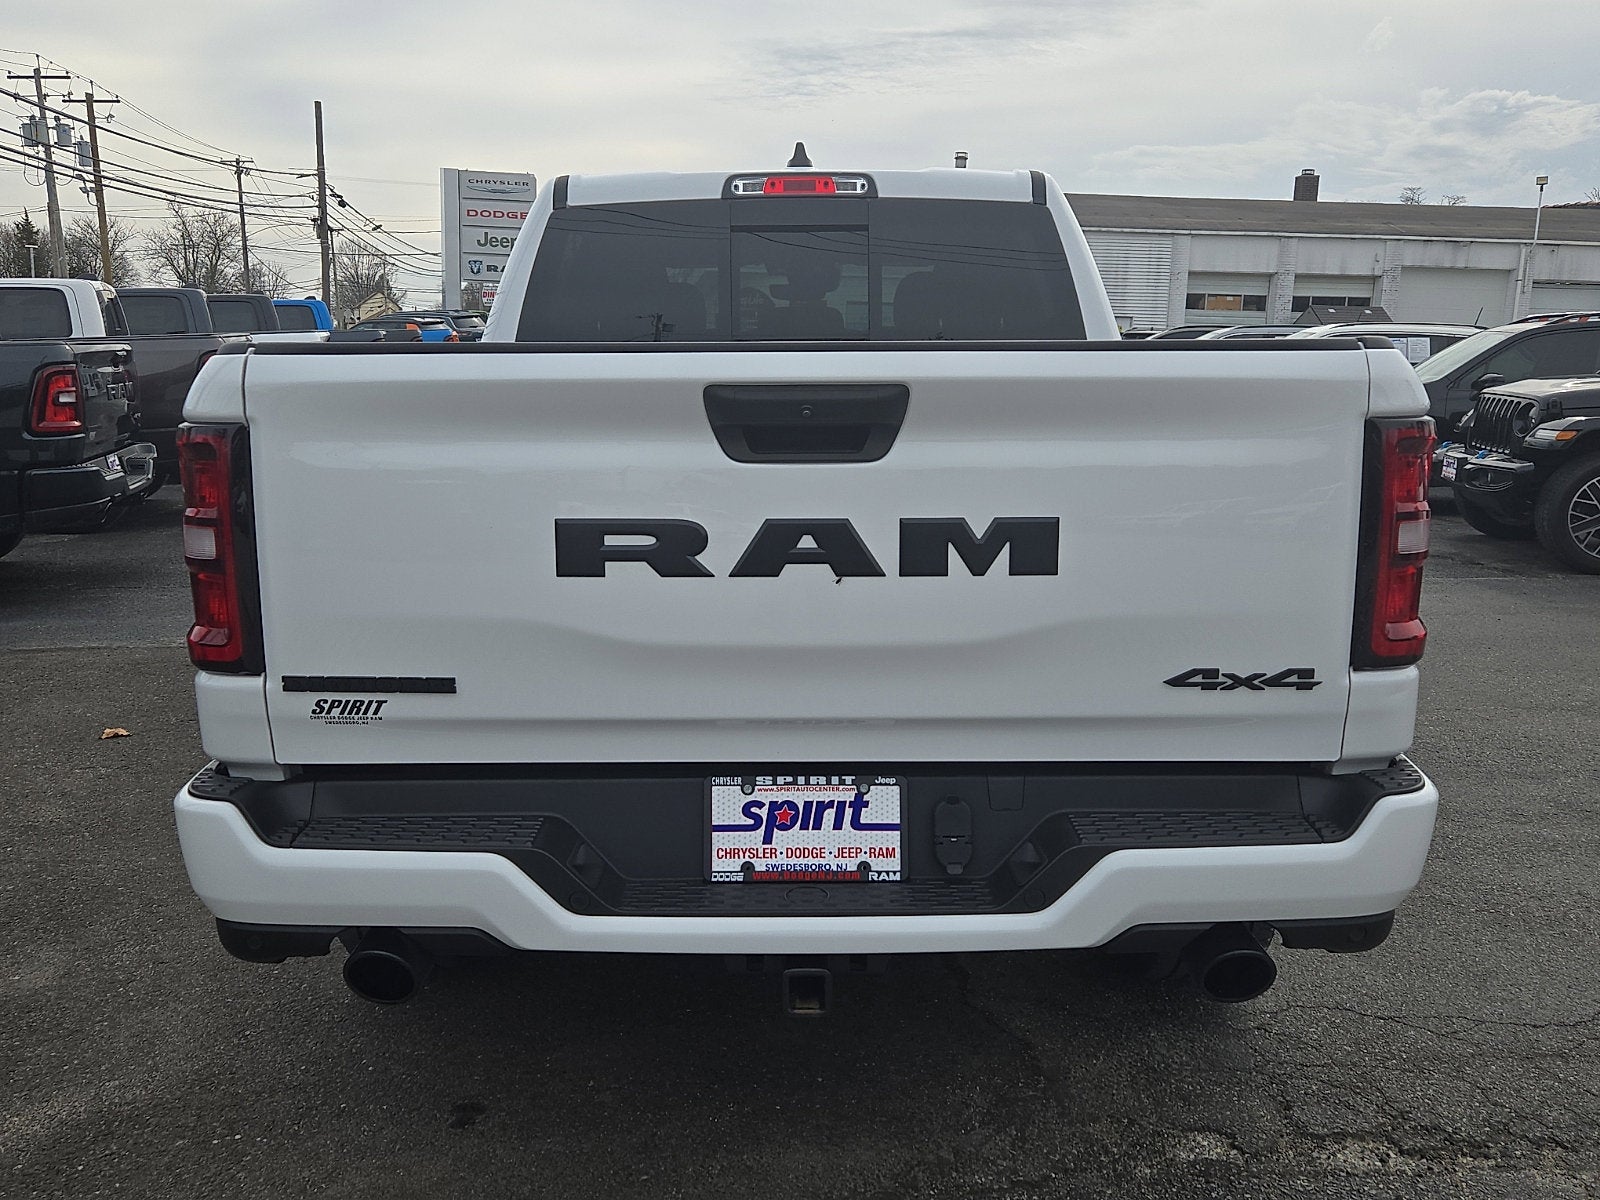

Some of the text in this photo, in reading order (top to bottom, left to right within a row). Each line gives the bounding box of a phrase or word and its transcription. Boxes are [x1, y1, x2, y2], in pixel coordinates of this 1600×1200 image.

[468, 178, 530, 187] CHRYSLER
[555, 517, 1060, 578] RAM
[1163, 668, 1323, 691] 4x4
[311, 699, 388, 716] SPIRIT
[711, 776, 742, 785] CHRYSLER
[755, 776, 856, 785] SPIRIT
[874, 776, 896, 785] Jeep
[757, 785, 856, 793] www.SPIRITAUTOCENTER.com
[741, 793, 870, 845] spirit
[716, 847, 896, 859] CHRYSLER DODGE JEEP RAM
[836, 863, 848, 871] NJ
[711, 872, 745, 882] DODGE
[868, 872, 900, 881] RAM
